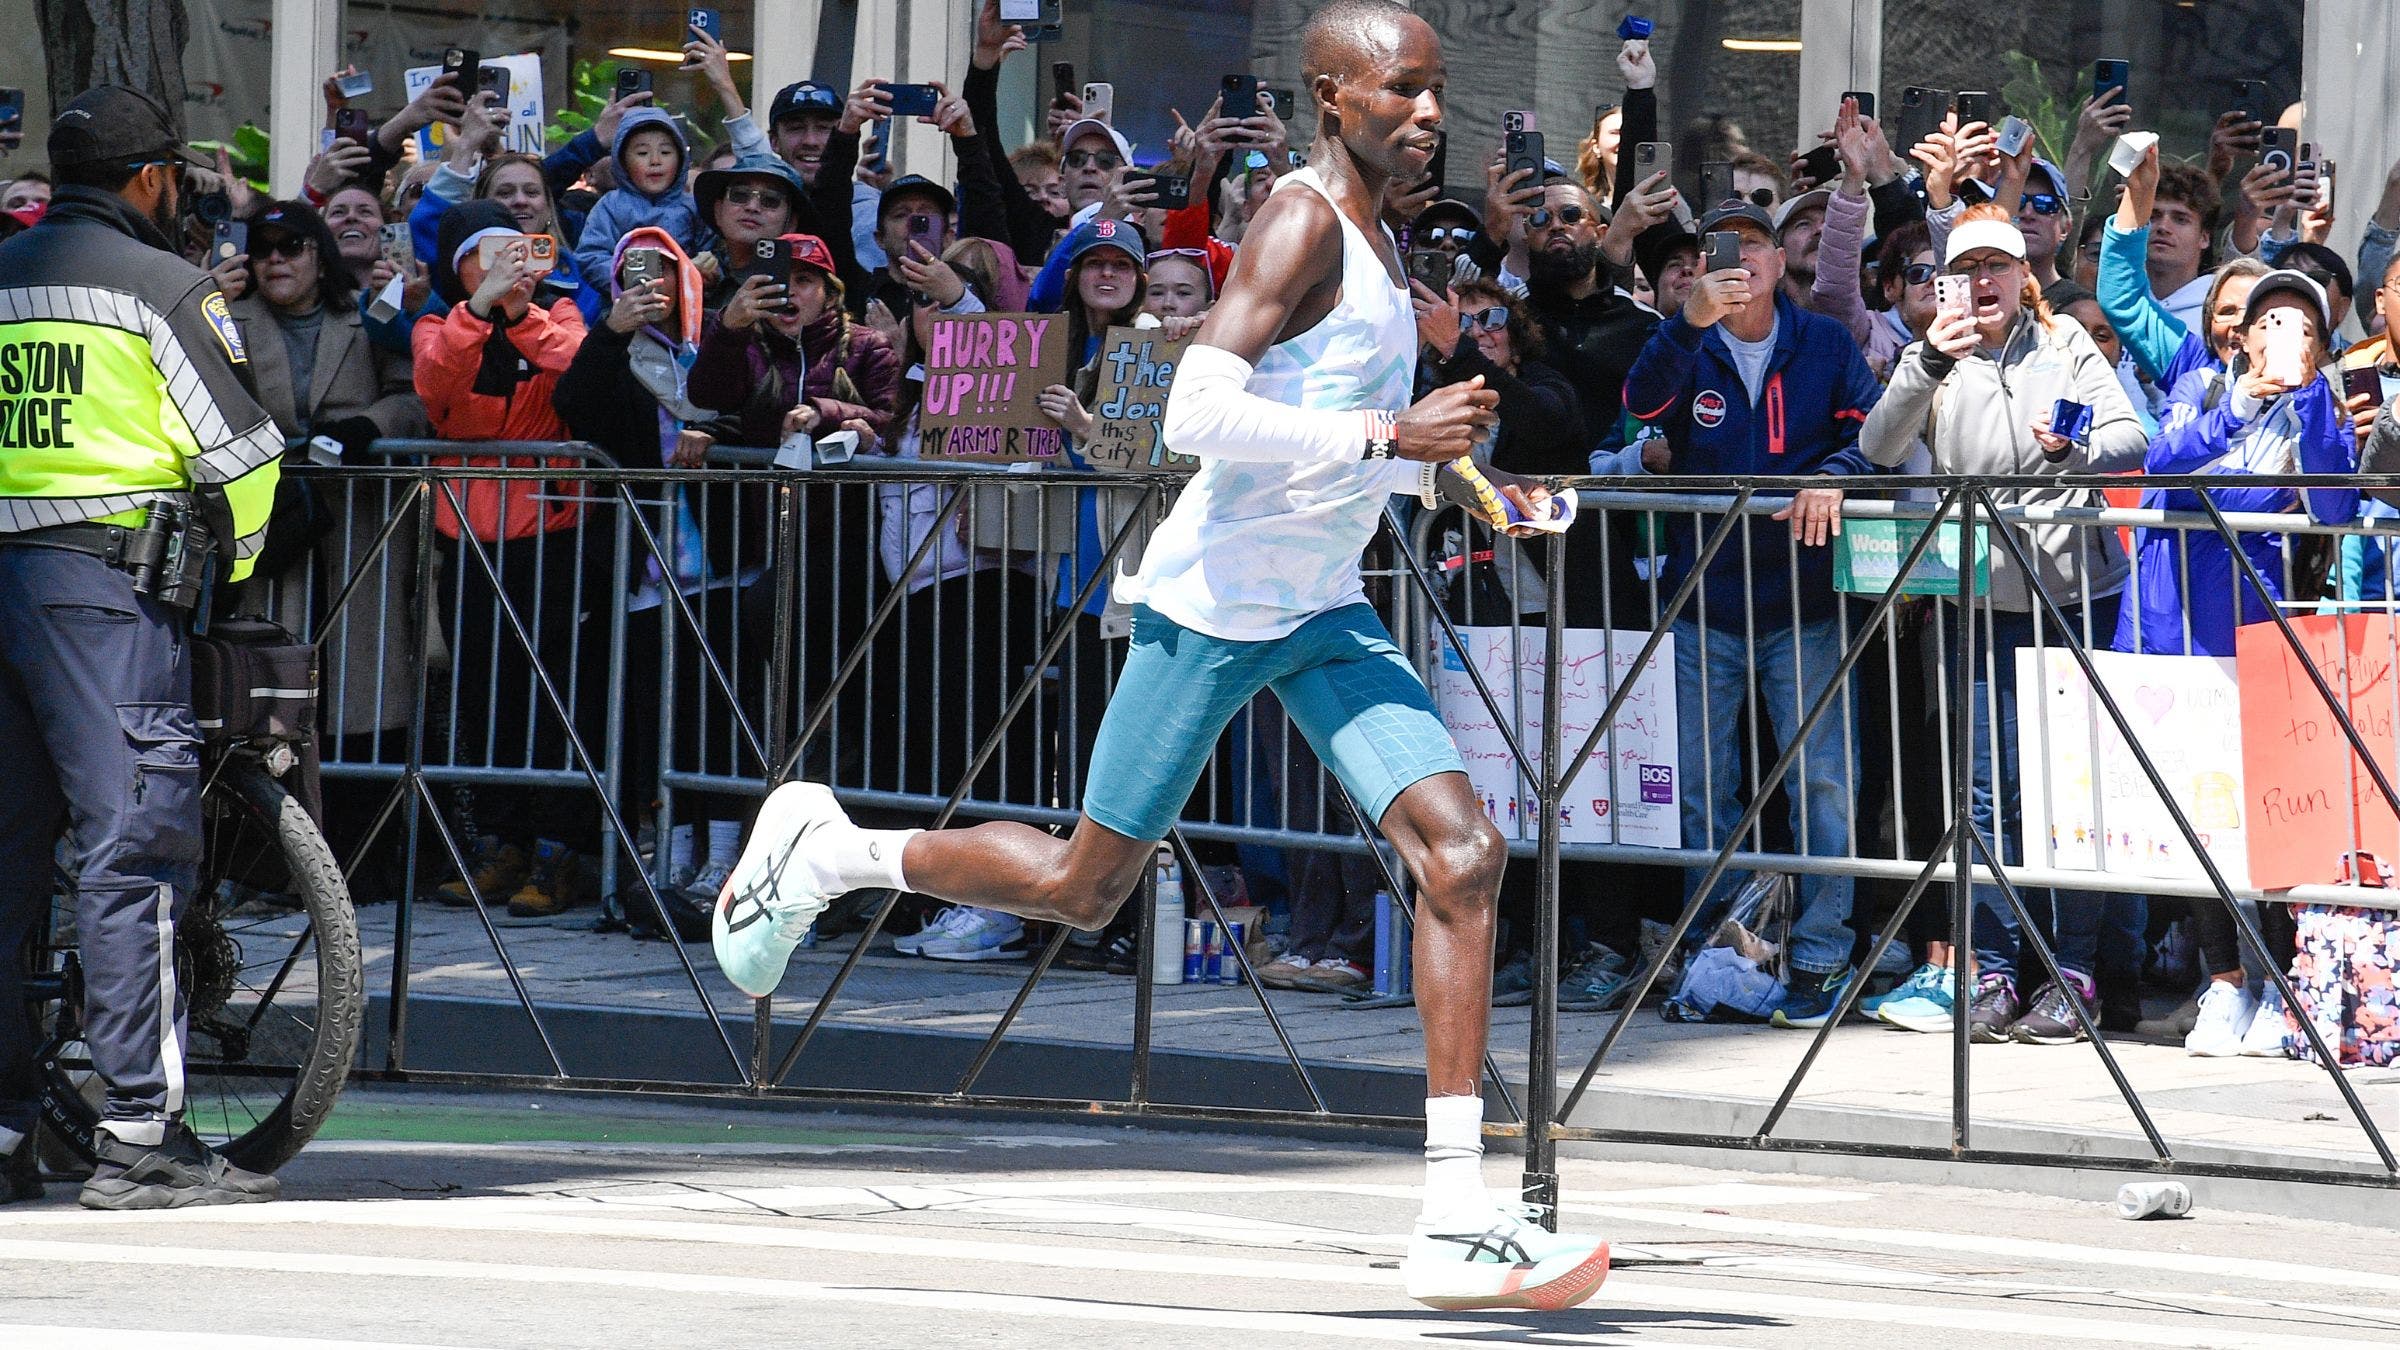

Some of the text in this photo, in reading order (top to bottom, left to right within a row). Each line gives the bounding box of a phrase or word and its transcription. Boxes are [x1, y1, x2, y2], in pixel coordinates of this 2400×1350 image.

[1095, 221, 1116, 238] B
[930, 319, 1050, 369] HURRY
[0, 341, 84, 395] STON
[926, 372, 1017, 417] UP!!!
[1100, 386, 1169, 420] don'
[0, 398, 75, 449] OLICE
[1102, 422, 1137, 441] this
[920, 426, 1063, 457] MY ARMS R TIRED
[1852, 534, 1904, 553] Wood
[2284, 718, 2319, 746] to
[1641, 767, 1672, 783] BOS
[2263, 787, 2332, 826] Run
